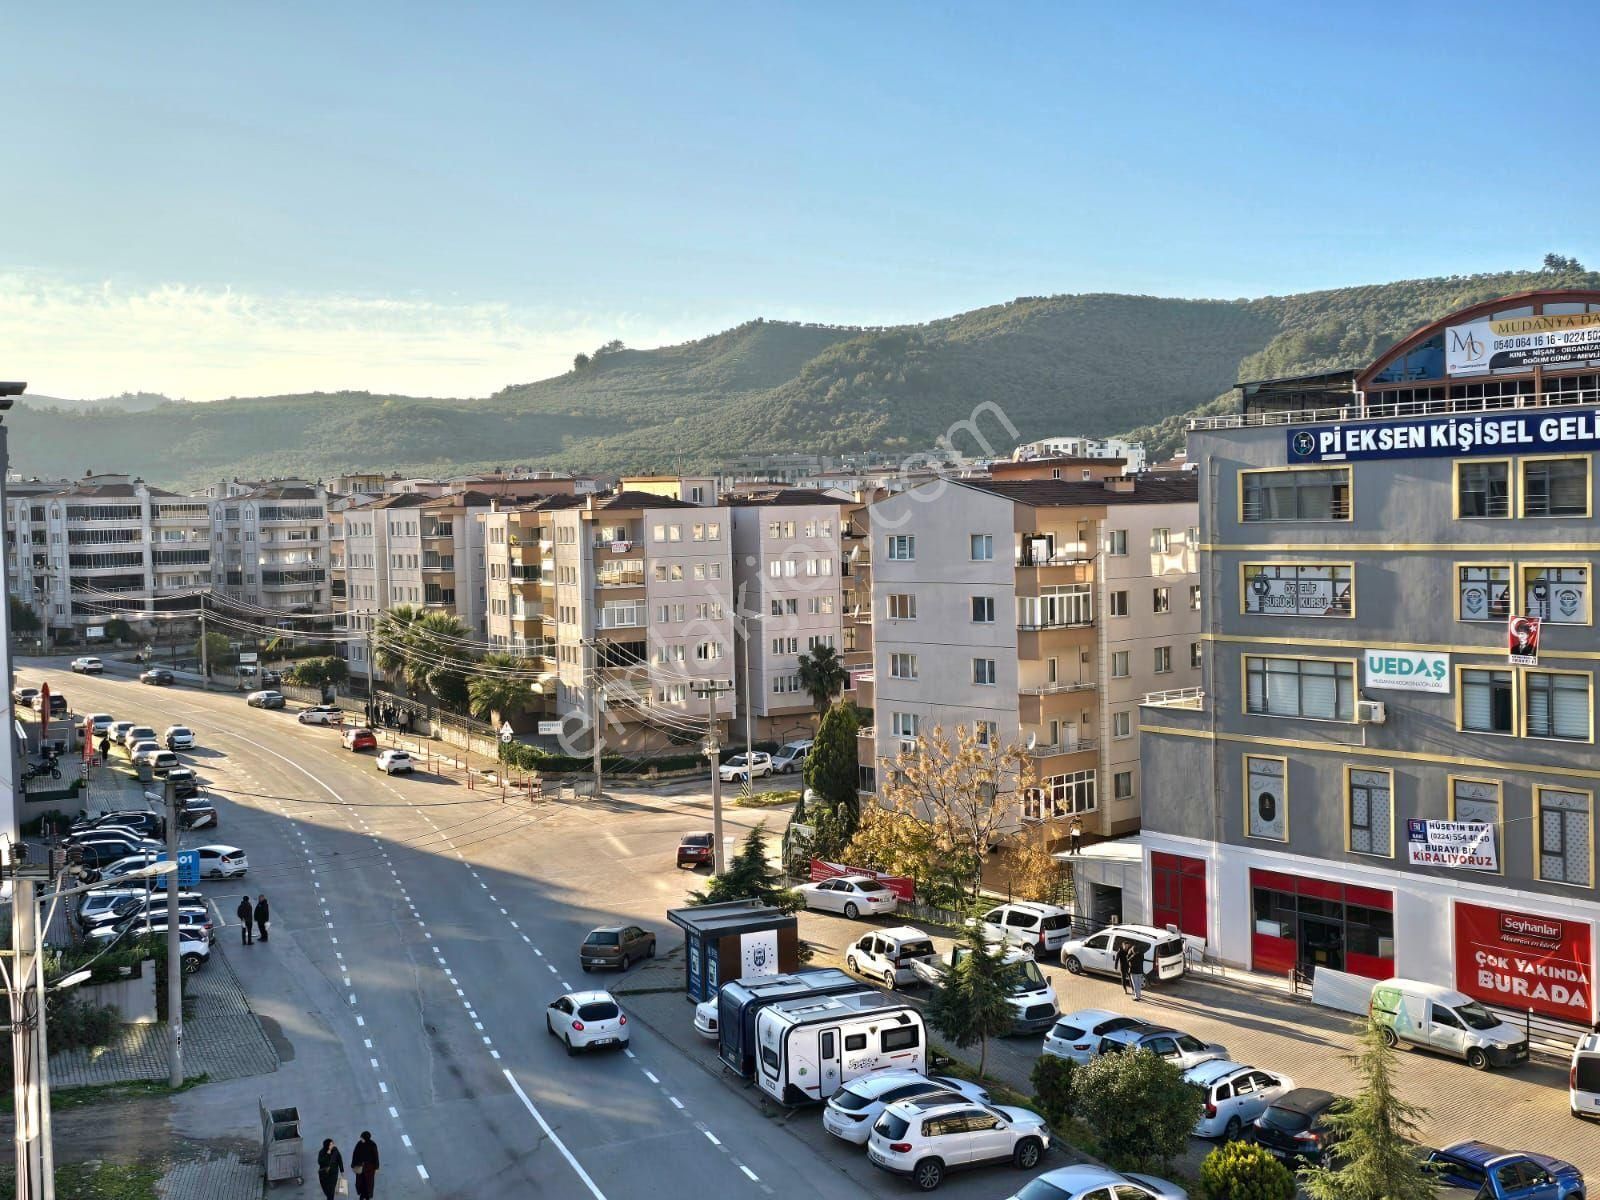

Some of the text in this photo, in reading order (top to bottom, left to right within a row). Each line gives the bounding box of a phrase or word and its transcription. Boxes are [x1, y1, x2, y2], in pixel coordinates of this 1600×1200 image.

[1498, 317, 1574, 333] MUDANYA
[1547, 335, 1556, 345] 16
[1564, 332, 1584, 344] 0224
[1523, 354, 1549, 364] DOĞUM
[1346, 426, 1425, 451] EKSEN
[1430, 417, 1533, 451] KİŞİSEL
[1369, 656, 1446, 680] UEDAŞ
[1429, 821, 1465, 832] HÜSEYİN
[1413, 849, 1493, 866] KİRALIYORUZ
[1505, 917, 1558, 936] Seyhanlar
[1475, 950, 1590, 985] ÇOK YAKINDA
[1478, 969, 1588, 1009] BURADA
